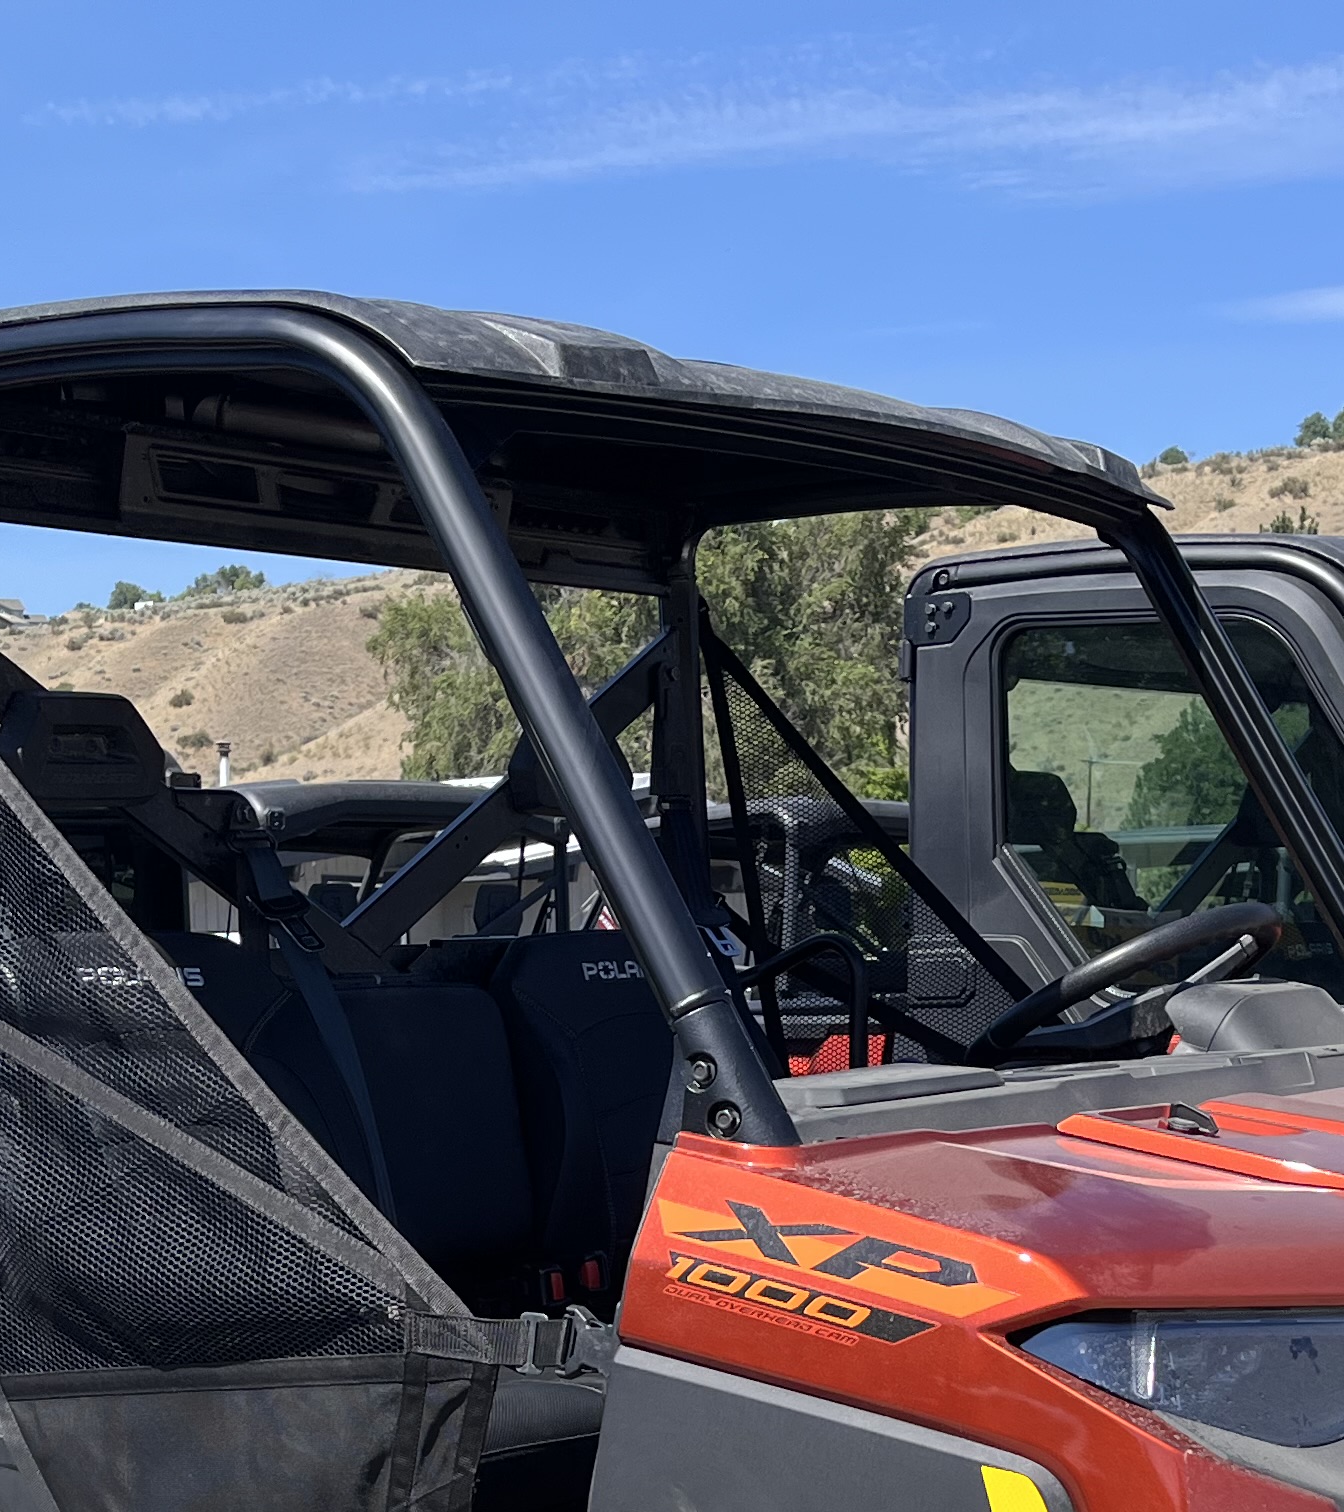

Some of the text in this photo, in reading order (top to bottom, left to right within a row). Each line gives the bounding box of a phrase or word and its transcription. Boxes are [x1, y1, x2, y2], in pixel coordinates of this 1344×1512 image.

[581, 960, 645, 980] POLA
[668, 1199, 978, 1287] XP
[664, 1256, 872, 1329] 1000
[666, 1285, 857, 1345] DUAL OVERHEAD CAM
